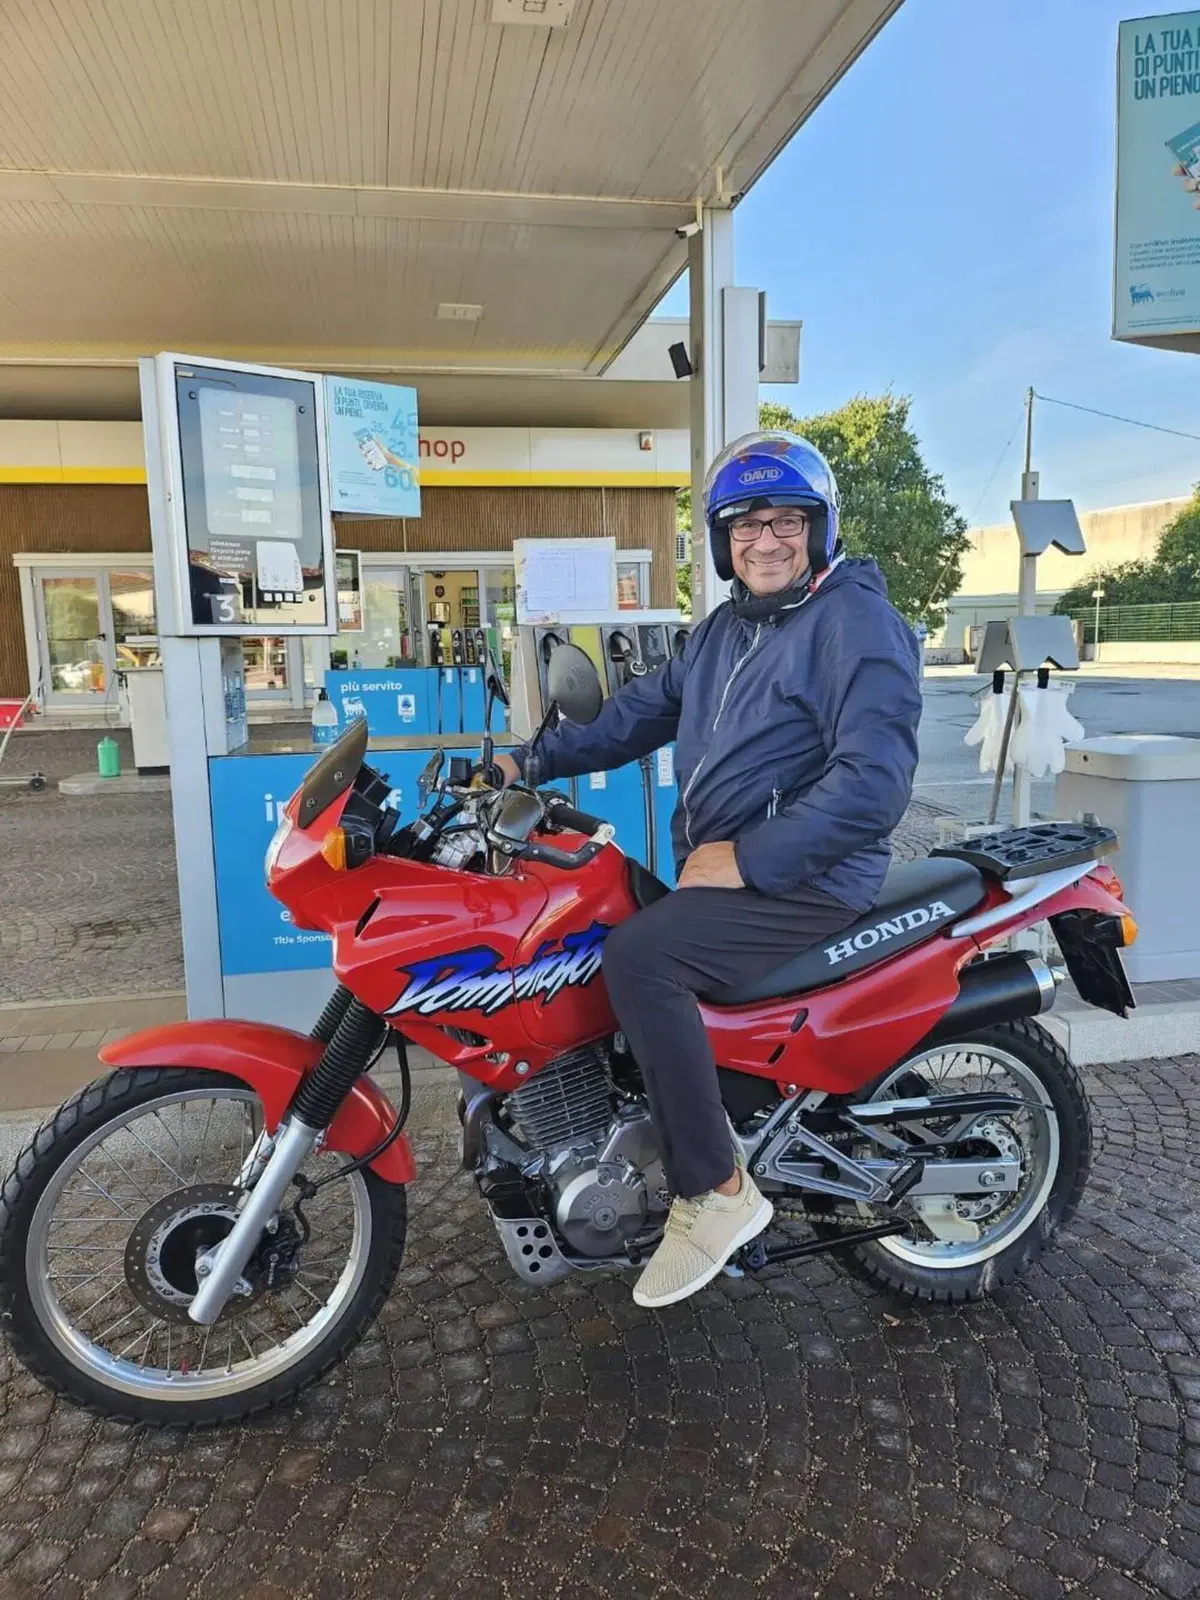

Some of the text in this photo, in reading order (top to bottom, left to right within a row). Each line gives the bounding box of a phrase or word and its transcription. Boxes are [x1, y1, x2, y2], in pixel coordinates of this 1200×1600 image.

[1135, 33, 1155, 55] LA
[1161, 29, 1193, 52] TUA
[1135, 50, 1199, 78] DI PUNTI
[1135, 78, 1155, 100] UN
[418, 433, 465, 464] hop
[743, 468, 779, 482] DAVID
[216, 595, 235, 622] 3
[341, 681, 402, 693] più servito
[272, 935, 335, 945] Title Sponso
[824, 900, 956, 965] HONDA
